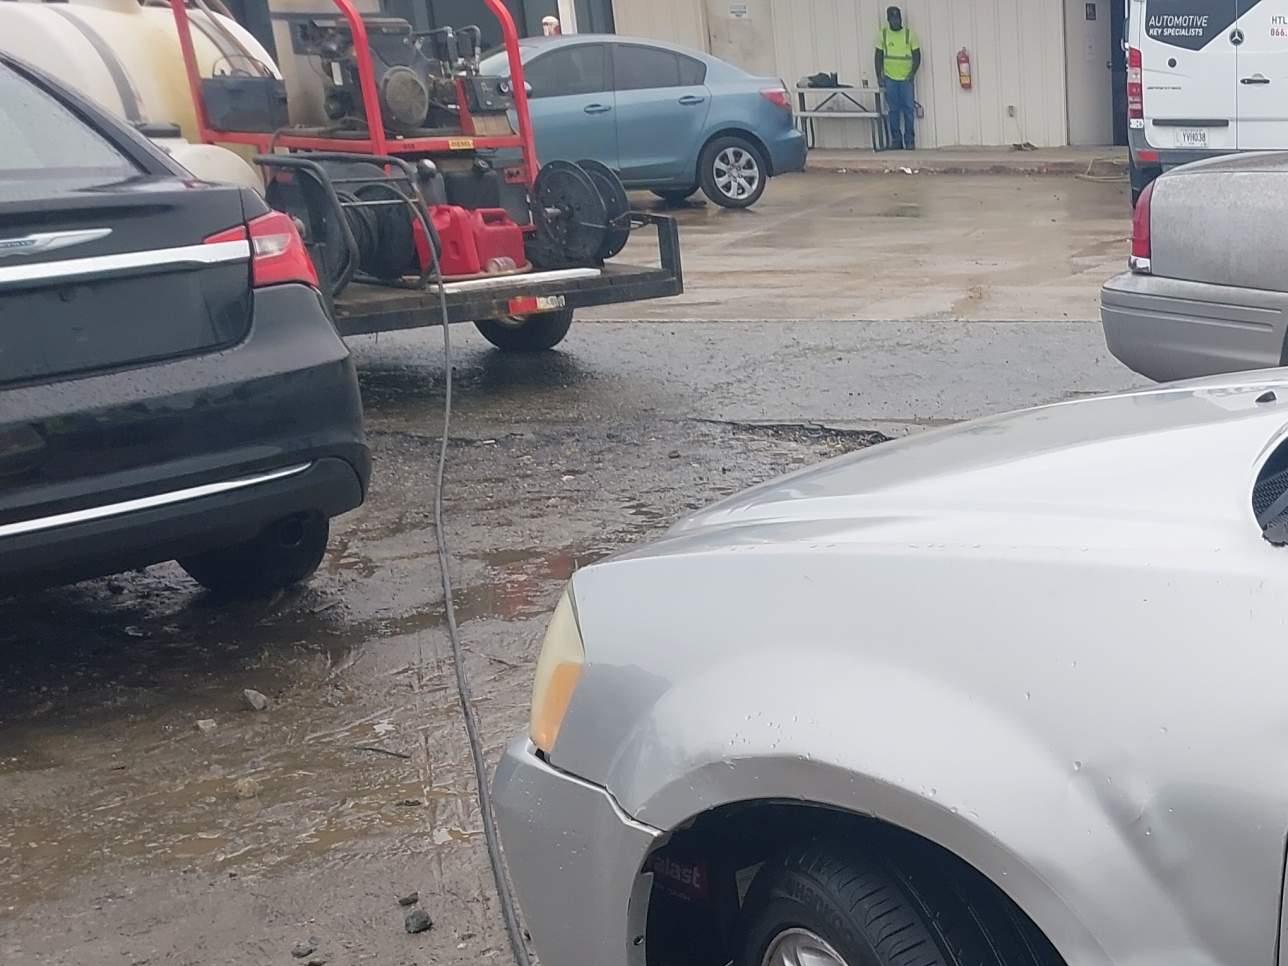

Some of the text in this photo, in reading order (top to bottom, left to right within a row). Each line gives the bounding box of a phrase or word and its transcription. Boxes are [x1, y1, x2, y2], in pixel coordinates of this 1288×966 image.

[1148, 15, 1208, 27] AUTOMOTIVE
[1149, 28, 1203, 36] KEY SPECIALISTS
